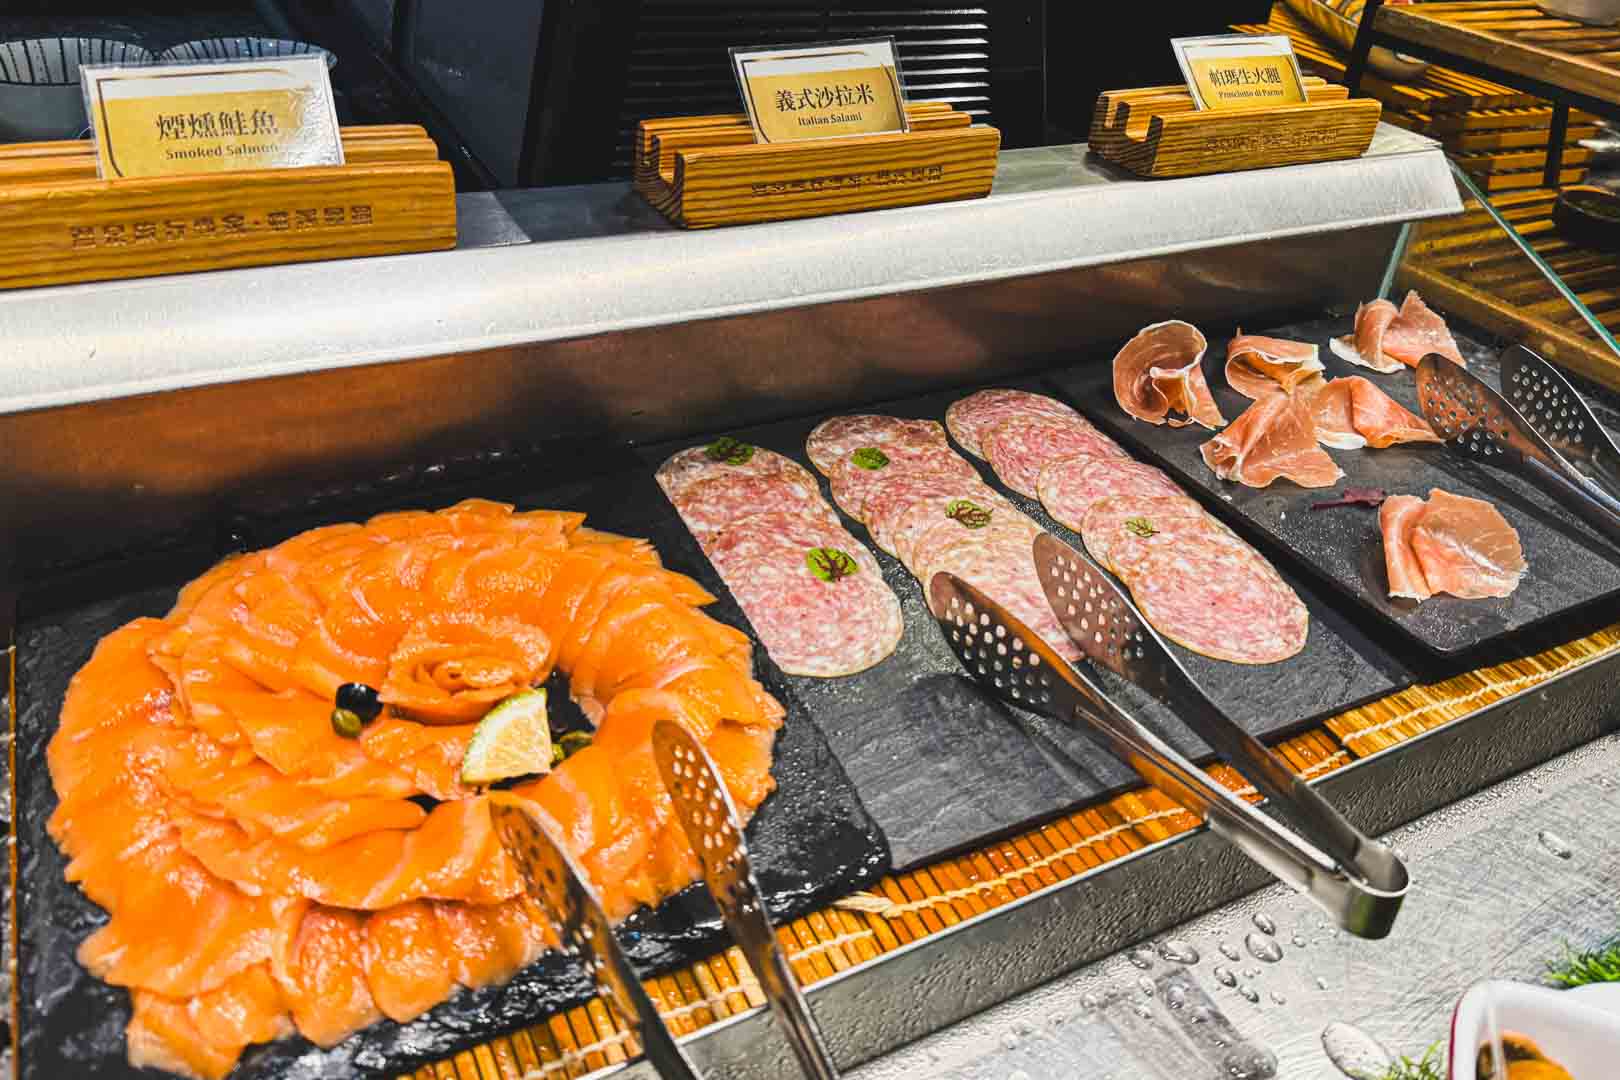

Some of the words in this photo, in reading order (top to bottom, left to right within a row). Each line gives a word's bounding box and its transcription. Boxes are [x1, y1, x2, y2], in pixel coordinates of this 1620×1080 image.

[1209, 66, 1282, 87] 帕瑪生火腿
[775, 83, 874, 112] 義式沙拉米
[156, 109, 278, 140] 煙燻鮭魚
[798, 117, 829, 126] Italian
[830, 112, 862, 124] Salami
[166, 145, 222, 160] Smoked
[226, 143, 279, 156] Salmon
